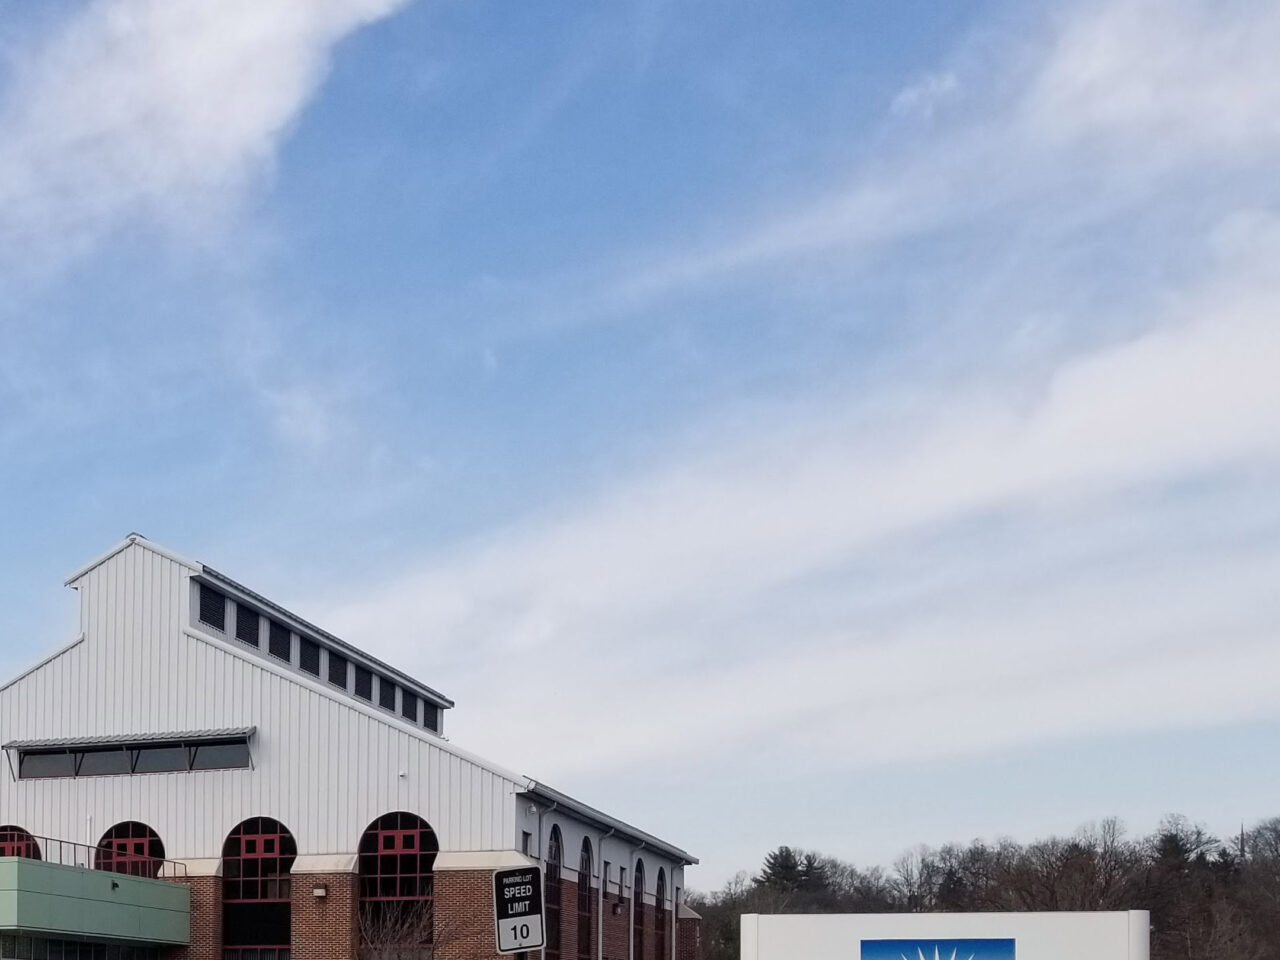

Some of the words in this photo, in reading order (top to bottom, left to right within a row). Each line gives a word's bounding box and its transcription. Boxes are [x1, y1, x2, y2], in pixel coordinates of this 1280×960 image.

[503, 876, 522, 884] PARKING
[504, 885, 533, 898] SPEED
[508, 901, 530, 914] LIMIT
[510, 923, 529, 940] 10
